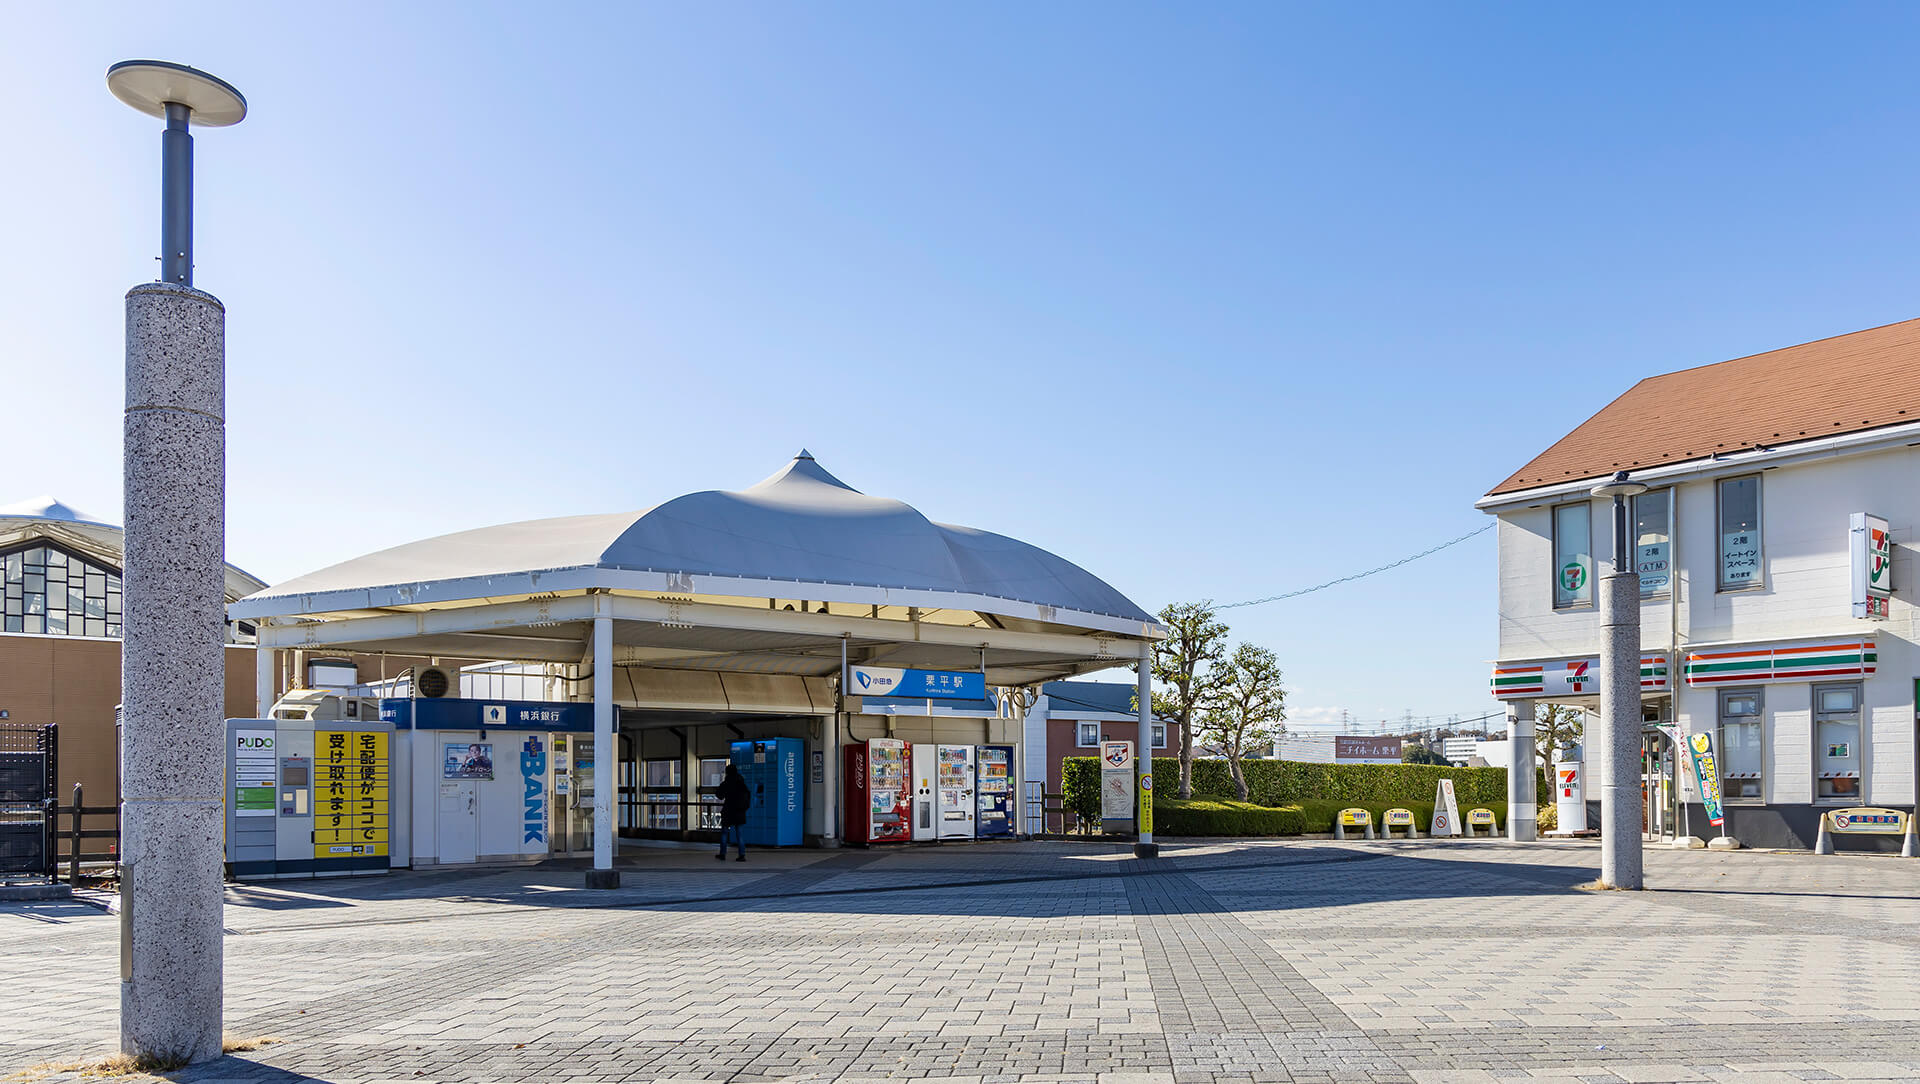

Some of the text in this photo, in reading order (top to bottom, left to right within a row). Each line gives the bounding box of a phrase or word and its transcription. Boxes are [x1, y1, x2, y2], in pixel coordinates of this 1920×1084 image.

[1725, 550, 1757, 559] イートイン
[1727, 559, 1755, 568] スペース
[872, 677, 893, 685] 小田急
[520, 710, 560, 721] 横浜銀行
[237, 737, 274, 748] PUDO
[360, 734, 376, 840] 宅配便がココで
[786, 752, 796, 811] amazon hub
[329, 734, 345, 841] 受け取れます！
[520, 752, 546, 844] BANK
